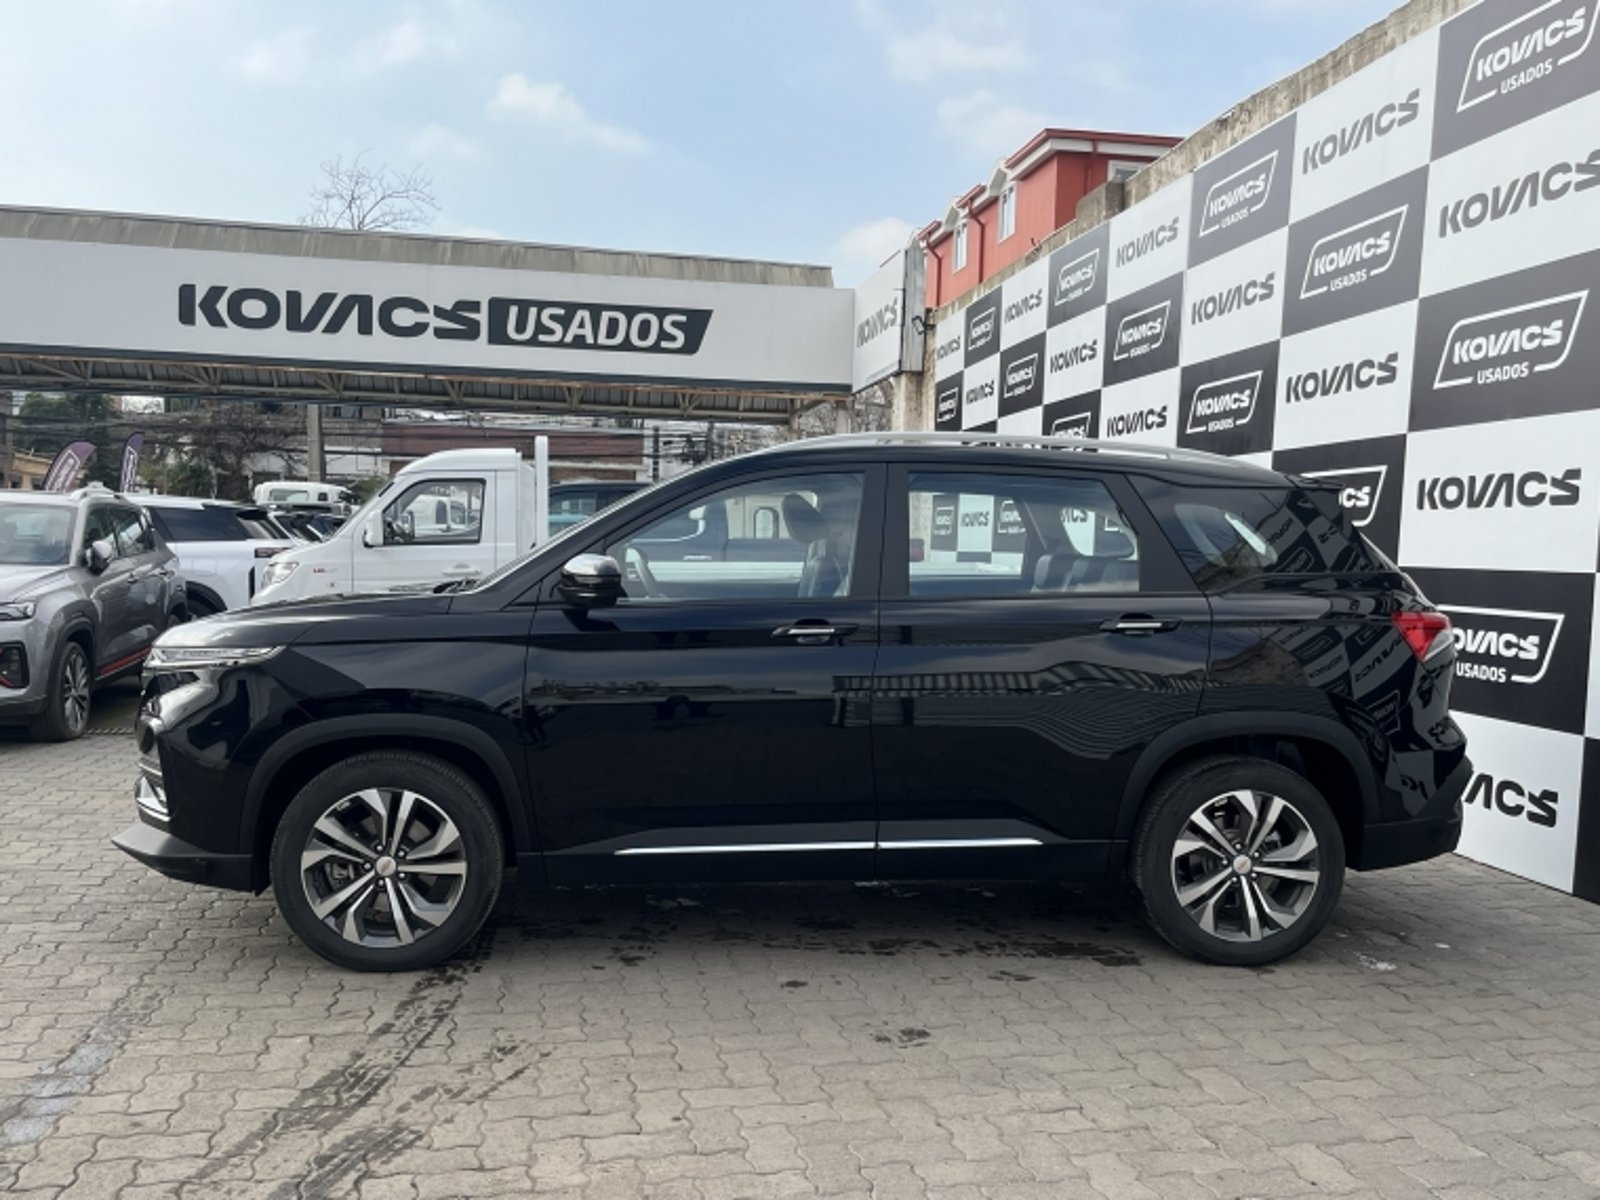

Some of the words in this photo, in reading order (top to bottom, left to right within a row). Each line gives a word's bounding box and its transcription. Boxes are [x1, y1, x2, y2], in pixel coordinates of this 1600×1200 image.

[1476, 6, 1586, 82] KOVACS
[1501, 58, 1552, 94] USADOS
[1302, 88, 1420, 175] KOVACS
[1210, 173, 1266, 217] KOVACS
[1439, 149, 1600, 238] KOVACS
[1116, 216, 1179, 268] KOVACS
[1313, 230, 1391, 276] KOVACS
[1191, 272, 1275, 325] KOVACS
[1330, 268, 1367, 291] USADOS
[178, 283, 481, 341] KOVACS
[506, 304, 688, 349] USADOS
[1453, 319, 1563, 364] KOVACS
[1286, 352, 1398, 404] KOVACS
[1477, 362, 1529, 384] USADOS
[1107, 405, 1168, 438] KOVACS
[1196, 389, 1251, 417] KOVACS
[1416, 467, 1582, 510] KOVACS
[1452, 627, 1540, 660] OVACS
[1456, 662, 1507, 683] USADOS
[1464, 773, 1559, 828] ACS
